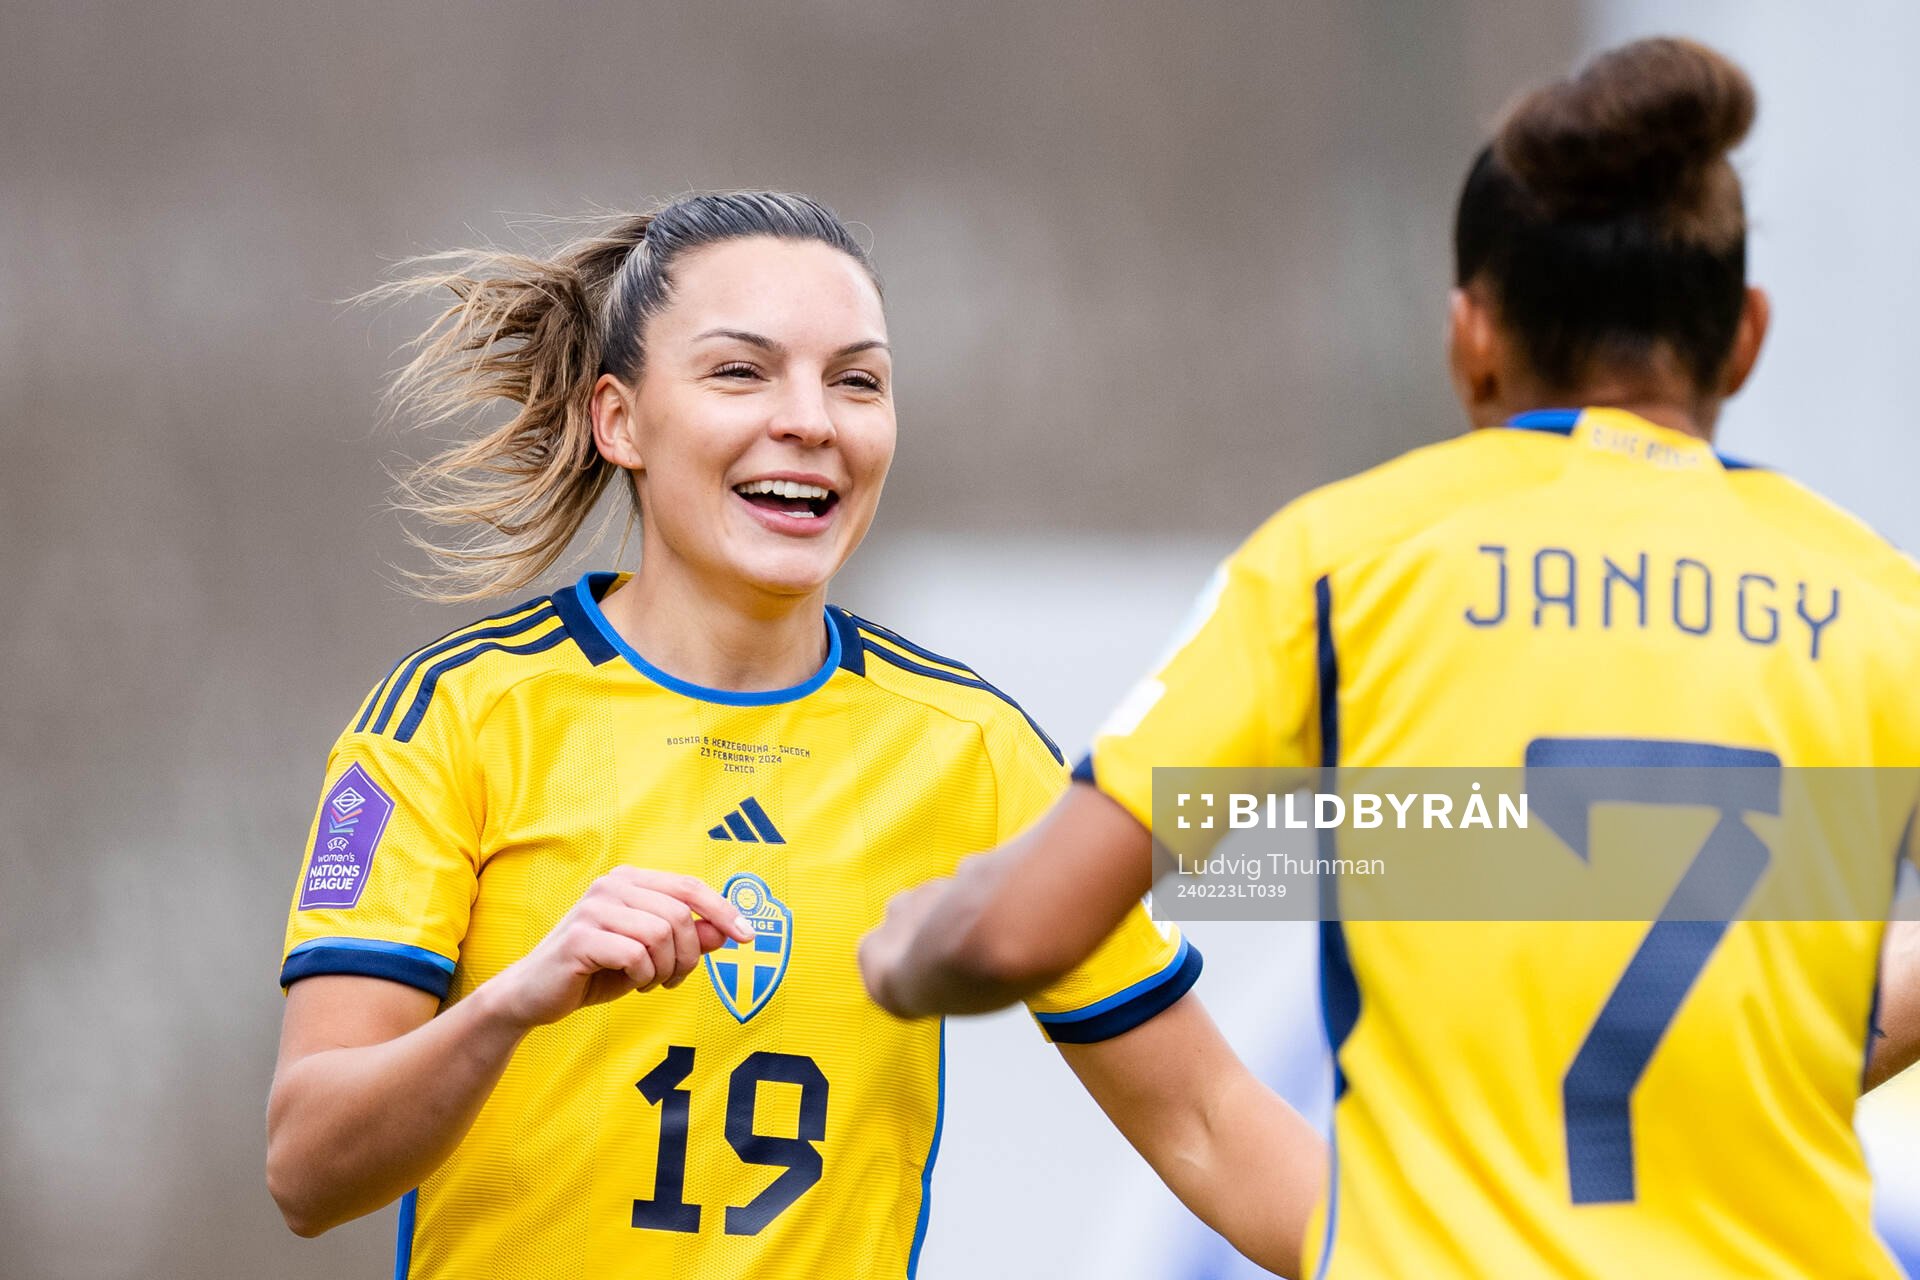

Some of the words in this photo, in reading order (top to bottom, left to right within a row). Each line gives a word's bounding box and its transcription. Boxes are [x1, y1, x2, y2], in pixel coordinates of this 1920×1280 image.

[1465, 545, 1840, 660] JANOGY
[667, 736, 700, 745] BOSNIA
[712, 738, 769, 753] HERZEGOVINA
[779, 745, 810, 758] SWEDEN
[701, 747, 710, 757] 23
[713, 750, 754, 763] FEBRUARY
[758, 755, 782, 763] 2024
[724, 764, 755, 774] ZENICA
[318, 852, 355, 863] women's
[309, 864, 360, 878] NATIONS
[309, 878, 354, 891] LEAGUE
[1525, 737, 1782, 1205] 7
[631, 1045, 829, 1236] 19
